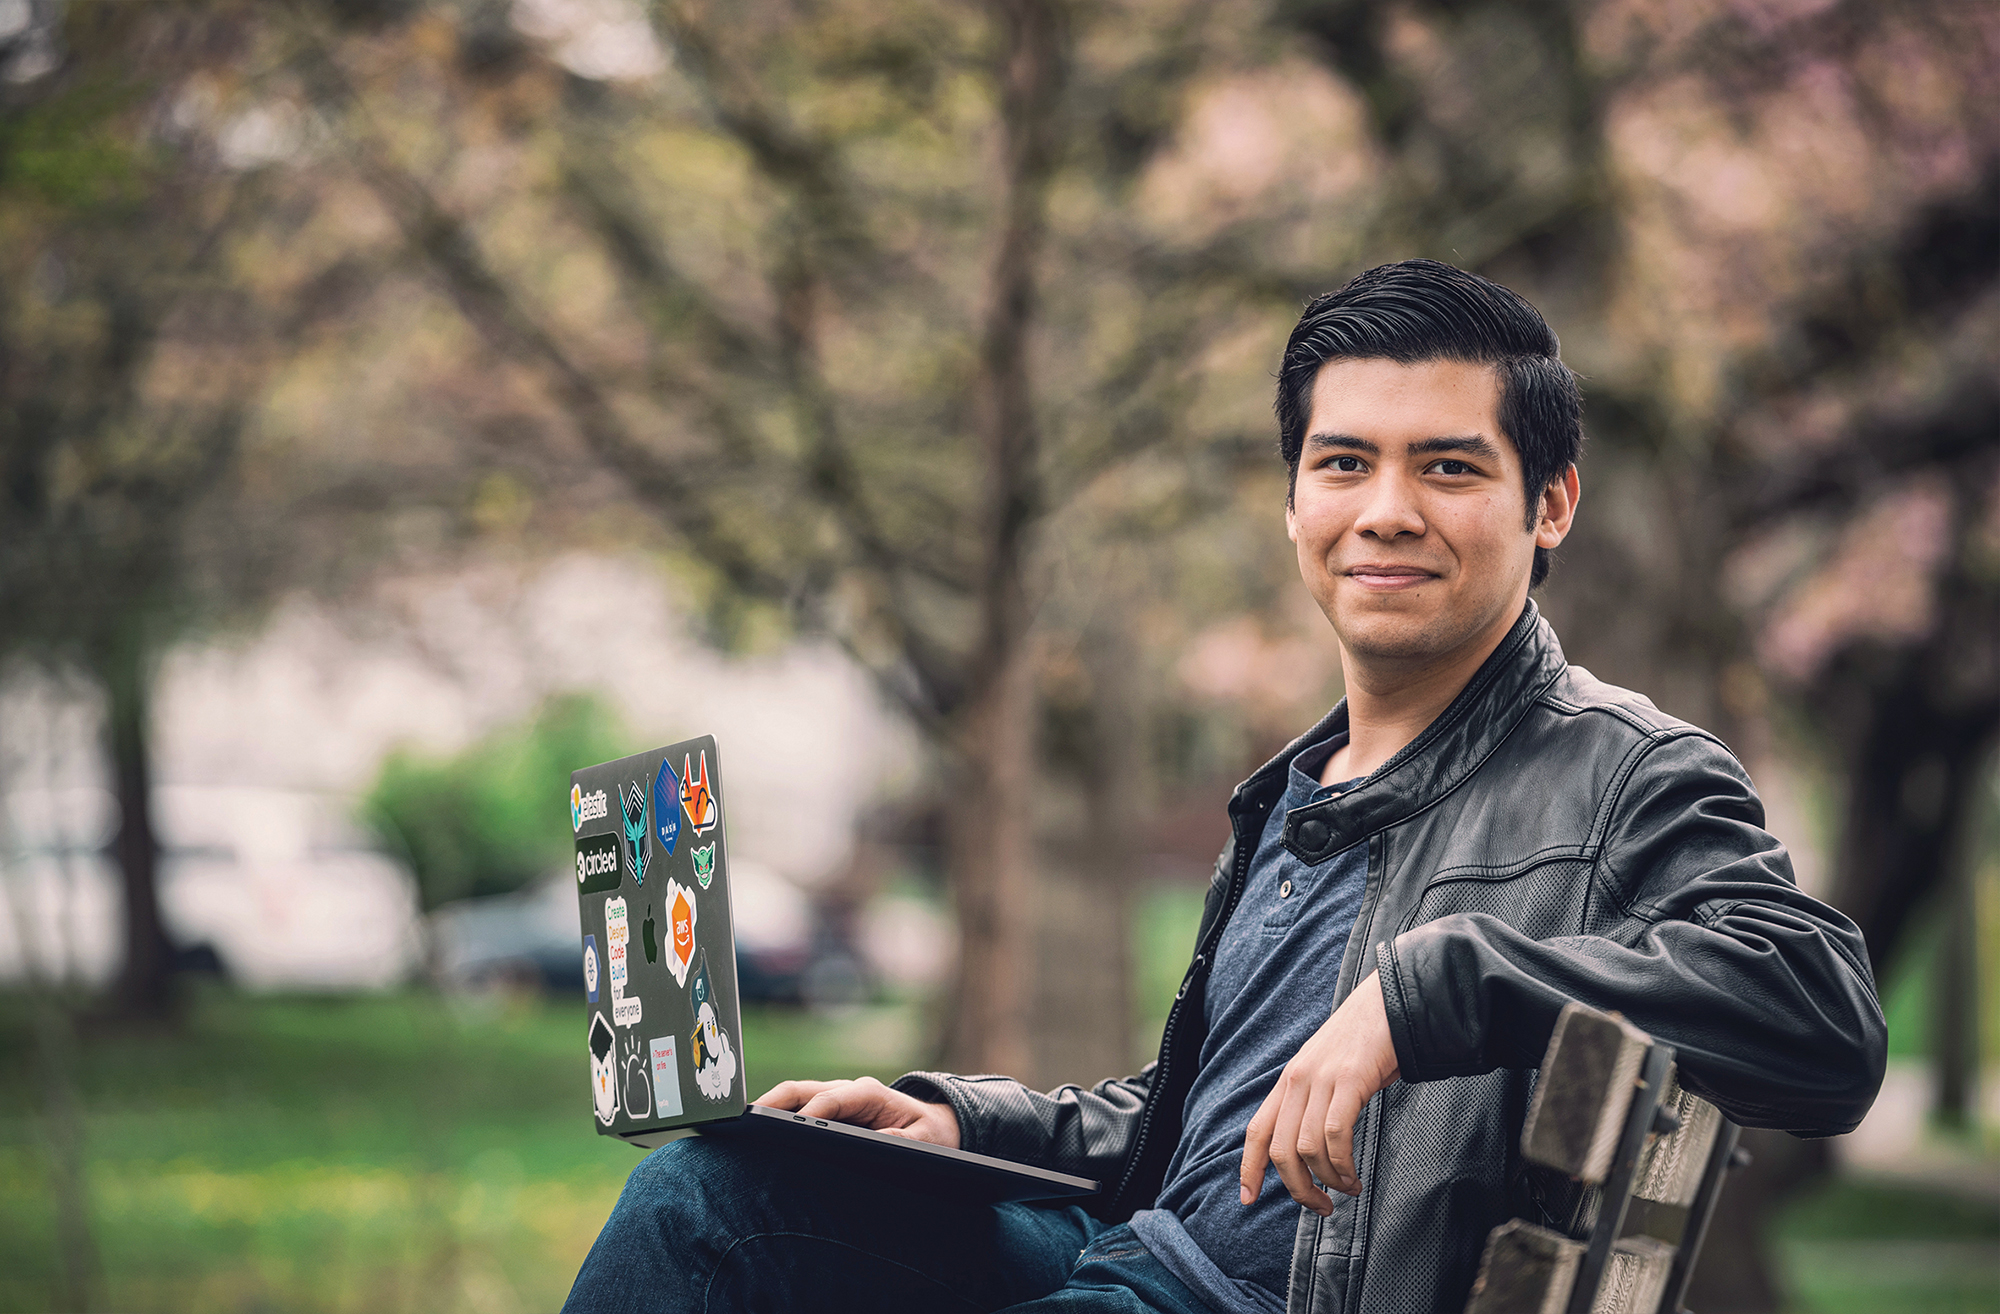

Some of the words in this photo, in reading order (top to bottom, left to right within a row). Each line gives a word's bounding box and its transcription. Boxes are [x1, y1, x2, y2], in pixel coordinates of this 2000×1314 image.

[583, 794, 605, 818] elastic
[661, 822, 677, 836] DASH
[585, 845, 617, 876] circleci
[607, 904, 625, 920] Create
[609, 924, 627, 942] Design
[676, 919, 689, 935] aws
[610, 944, 625, 960] Code
[612, 963, 625, 980] Build
[615, 1004, 639, 1020] everyone
